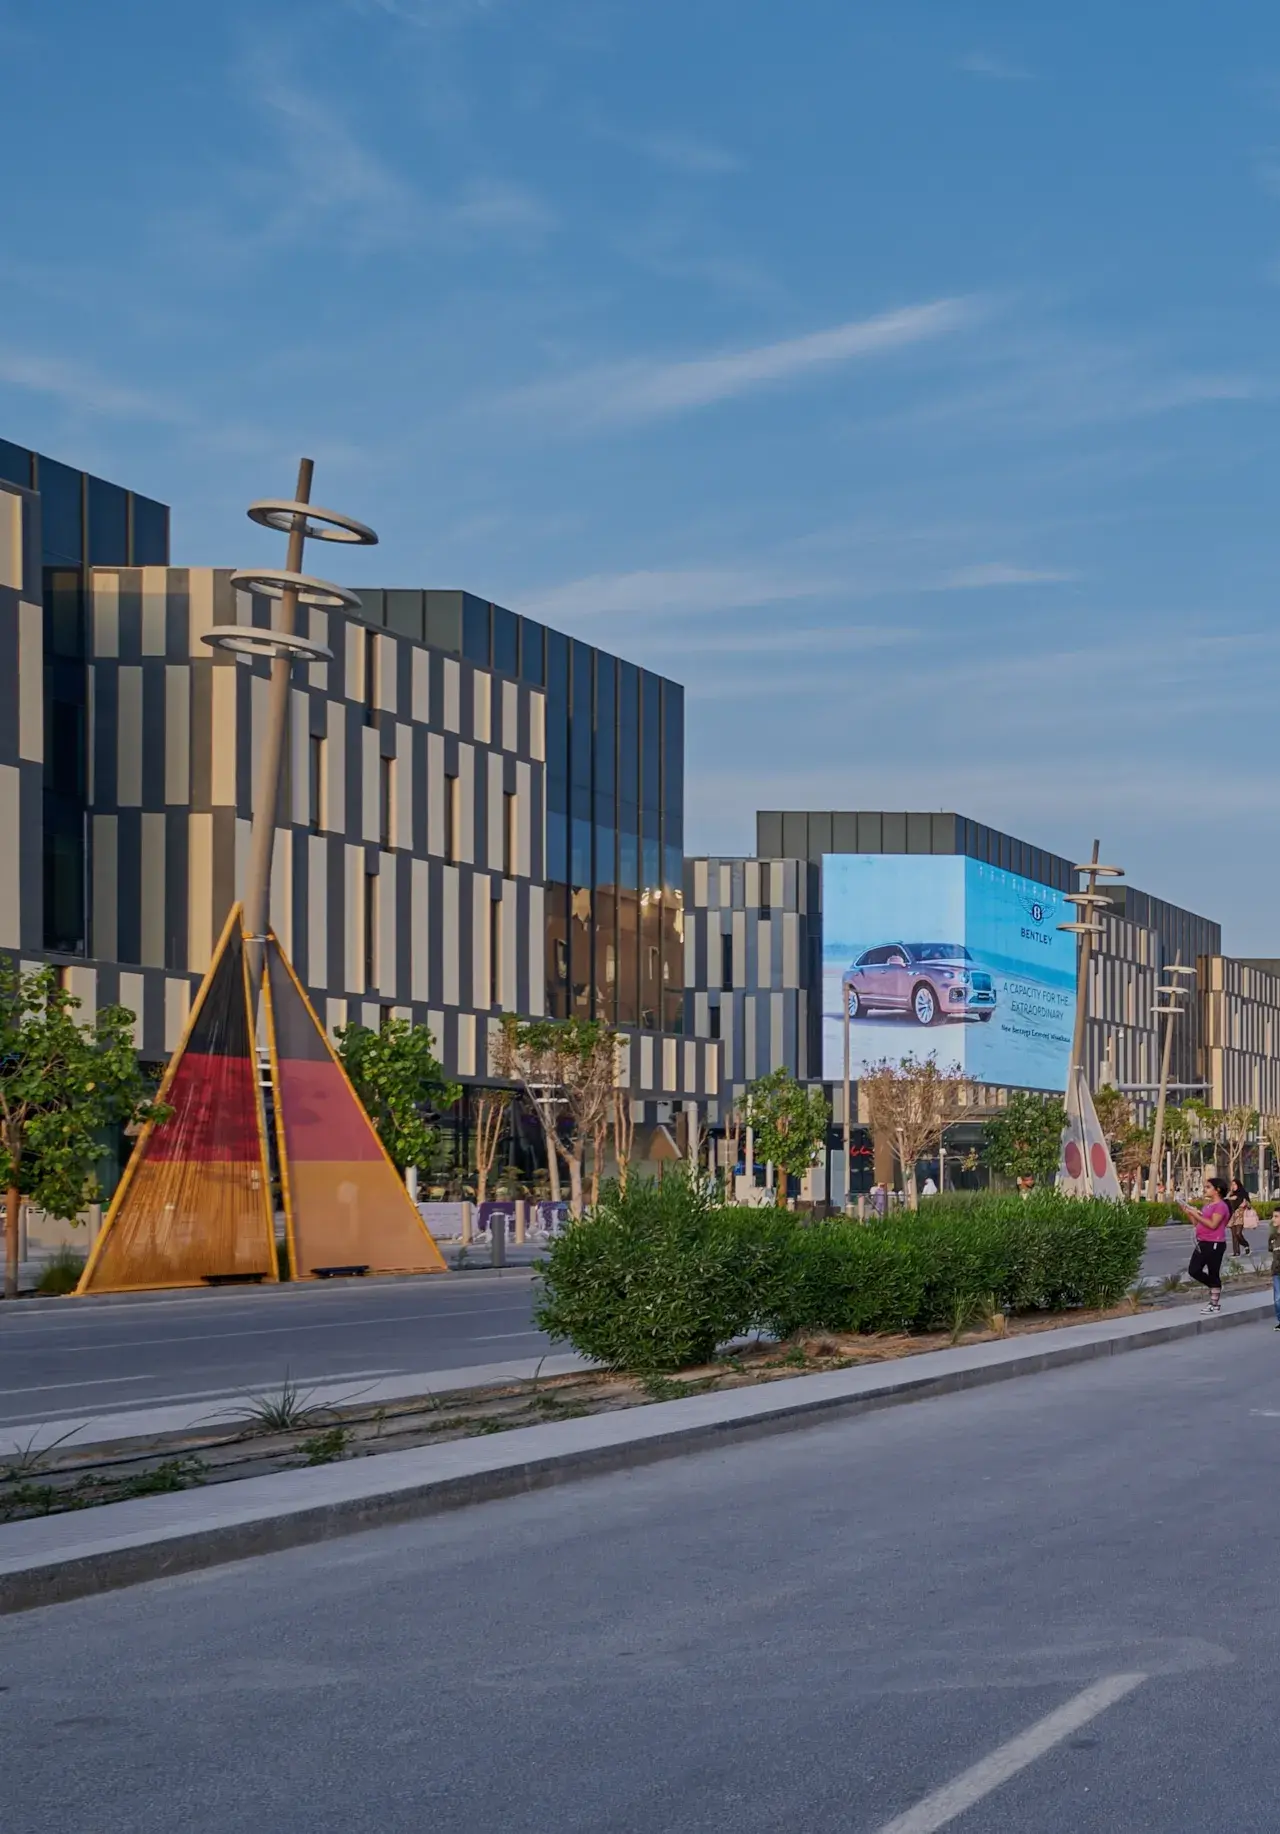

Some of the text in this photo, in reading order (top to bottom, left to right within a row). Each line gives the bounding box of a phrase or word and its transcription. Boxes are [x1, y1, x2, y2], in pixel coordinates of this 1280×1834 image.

[1021, 928, 1053, 946] BENTLEY
[1003, 982, 1069, 1006] A CAPACITY FOR THE
[1011, 1000, 1064, 1020] EXTRAORDINARY
